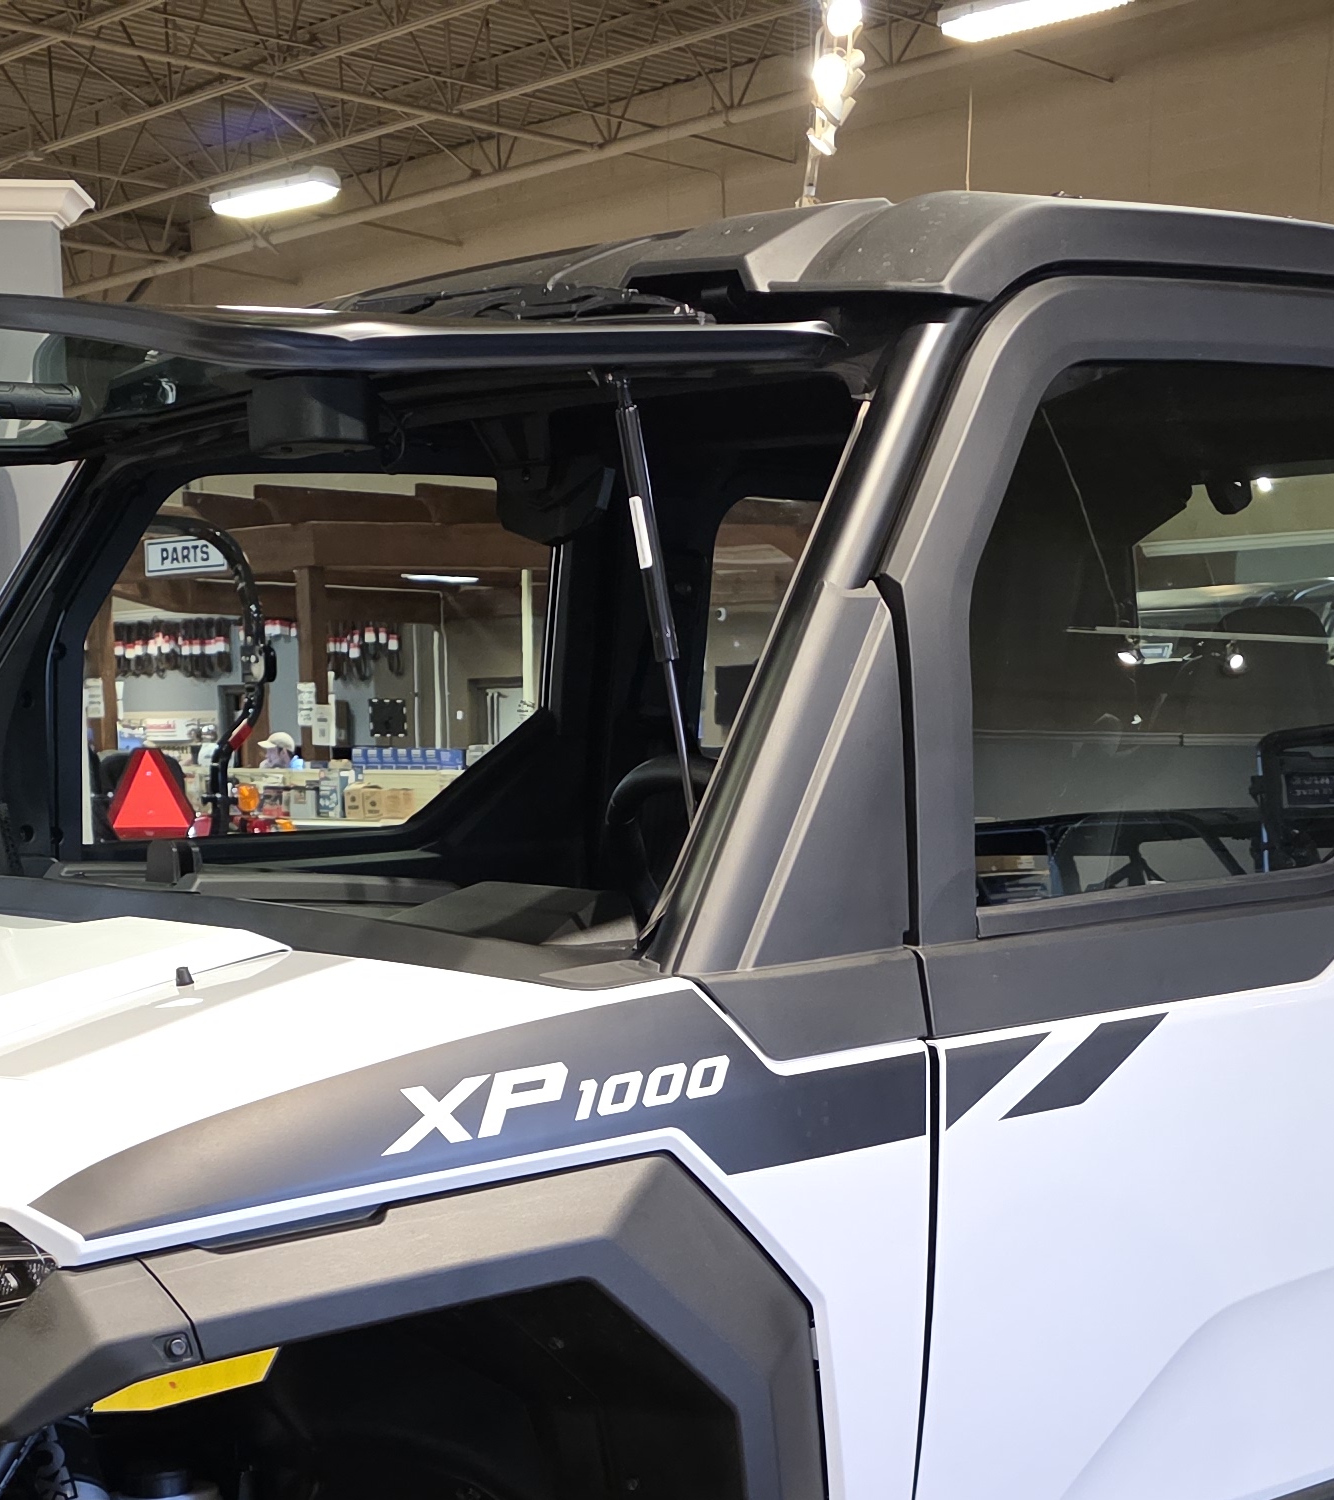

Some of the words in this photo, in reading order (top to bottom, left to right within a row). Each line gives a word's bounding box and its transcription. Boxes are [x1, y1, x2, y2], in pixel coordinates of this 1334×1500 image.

[160, 543, 210, 567] PARTS
[380, 1060, 569, 1157] XP
[574, 1053, 731, 1122] 1000
